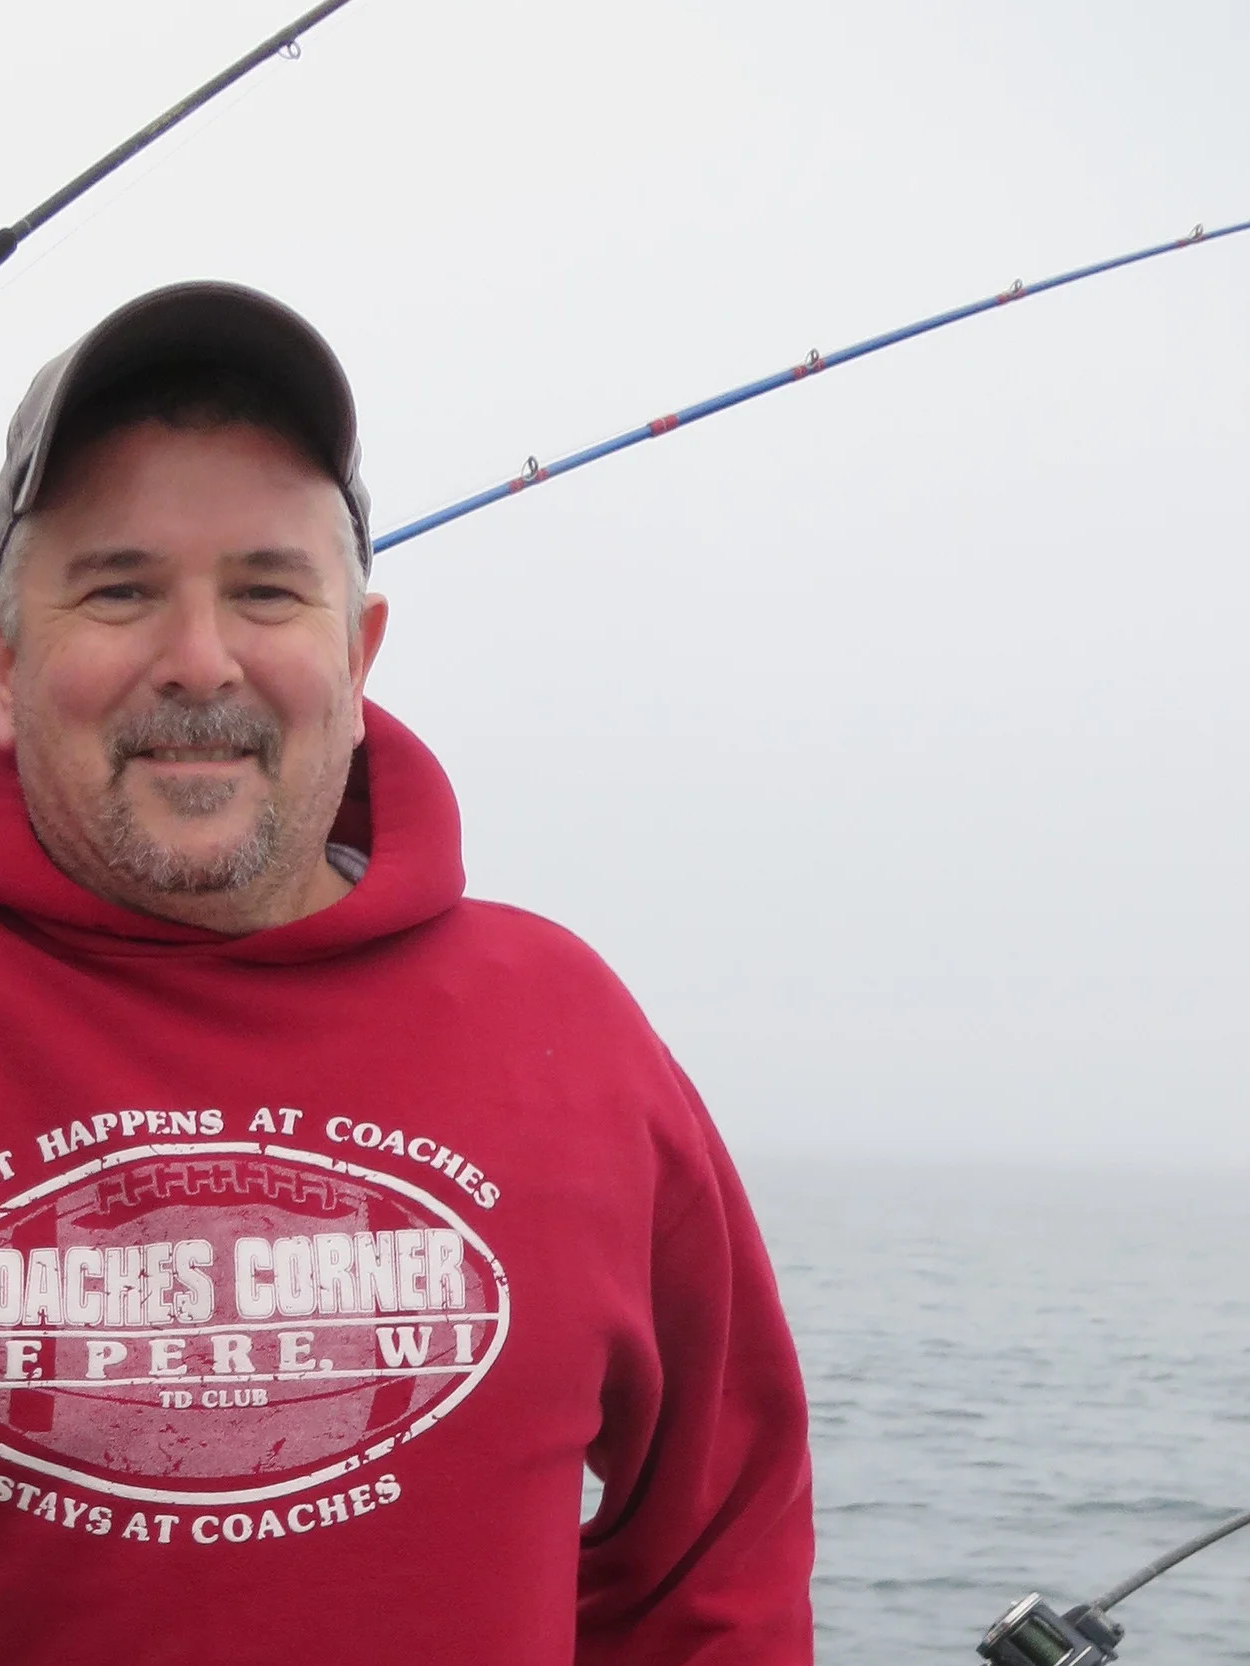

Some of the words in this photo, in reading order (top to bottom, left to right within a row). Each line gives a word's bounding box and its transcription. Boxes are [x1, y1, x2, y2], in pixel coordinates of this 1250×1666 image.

[36, 1109, 224, 1163] HAPPENS
[248, 1107, 303, 1136] AT
[325, 1116, 501, 1209] COACHES
[234, 1227, 466, 1320] CORNER
[376, 1323, 474, 1368] WI
[158, 1390, 194, 1409] TD
[201, 1387, 269, 1409] CLUB
[123, 1512, 180, 1543] AT
[191, 1473, 402, 1544] COACHES
